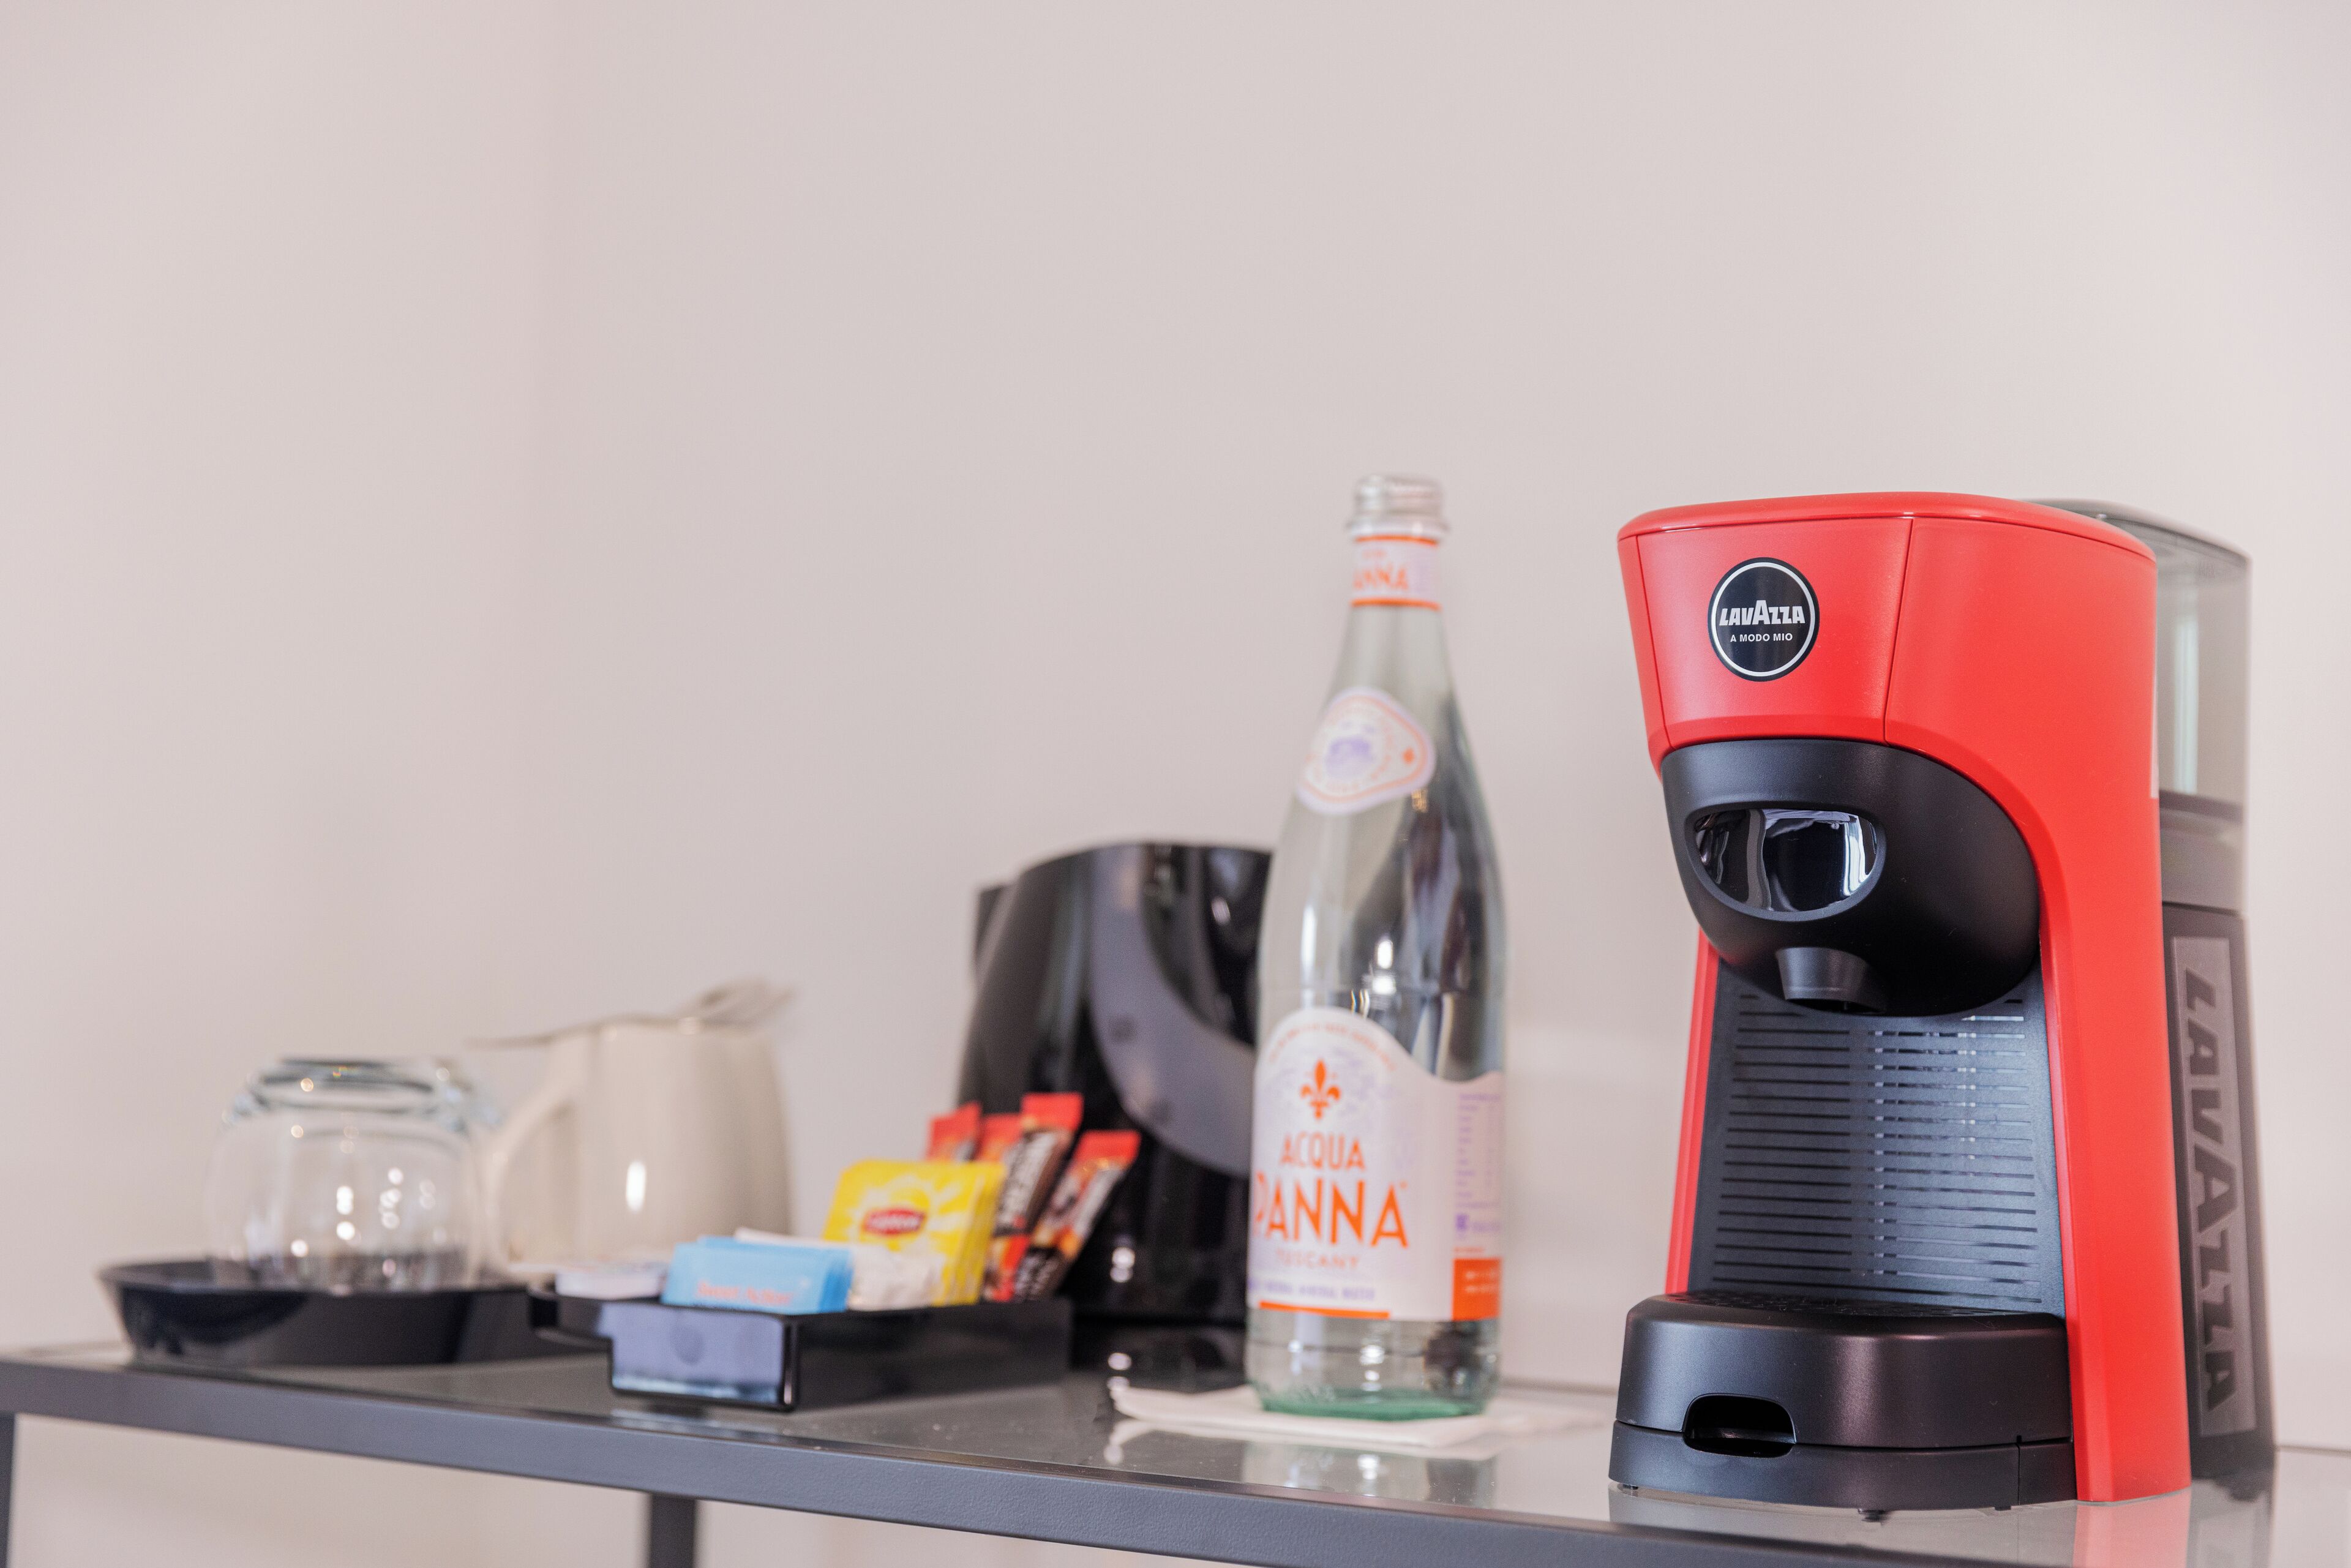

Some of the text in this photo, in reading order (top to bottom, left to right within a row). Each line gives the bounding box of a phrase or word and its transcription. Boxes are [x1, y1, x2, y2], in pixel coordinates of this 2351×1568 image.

[1719, 599, 1805, 626] LAVAZZA
[1773, 632, 1793, 641] MIO
[1280, 1132, 1366, 1171] ACQUA
[2185, 967, 2238, 1411] LAVAZZA
